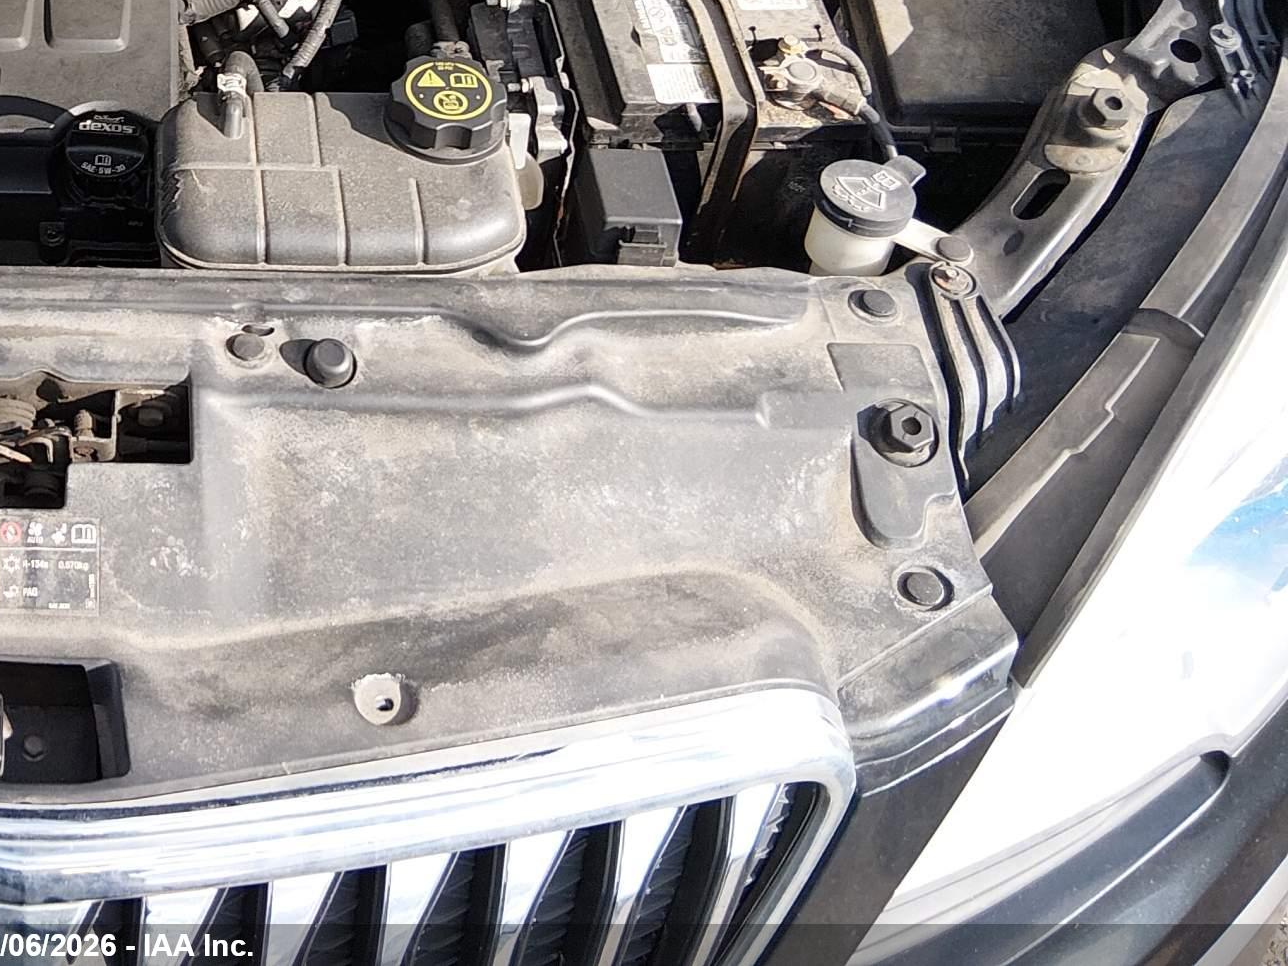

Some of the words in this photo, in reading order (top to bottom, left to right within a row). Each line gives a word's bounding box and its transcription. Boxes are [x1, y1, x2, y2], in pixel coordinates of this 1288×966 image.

[78, 120, 136, 134] dexos
[80, 161, 96, 173] SAE
[98, 164, 127, 174] 5W-30
